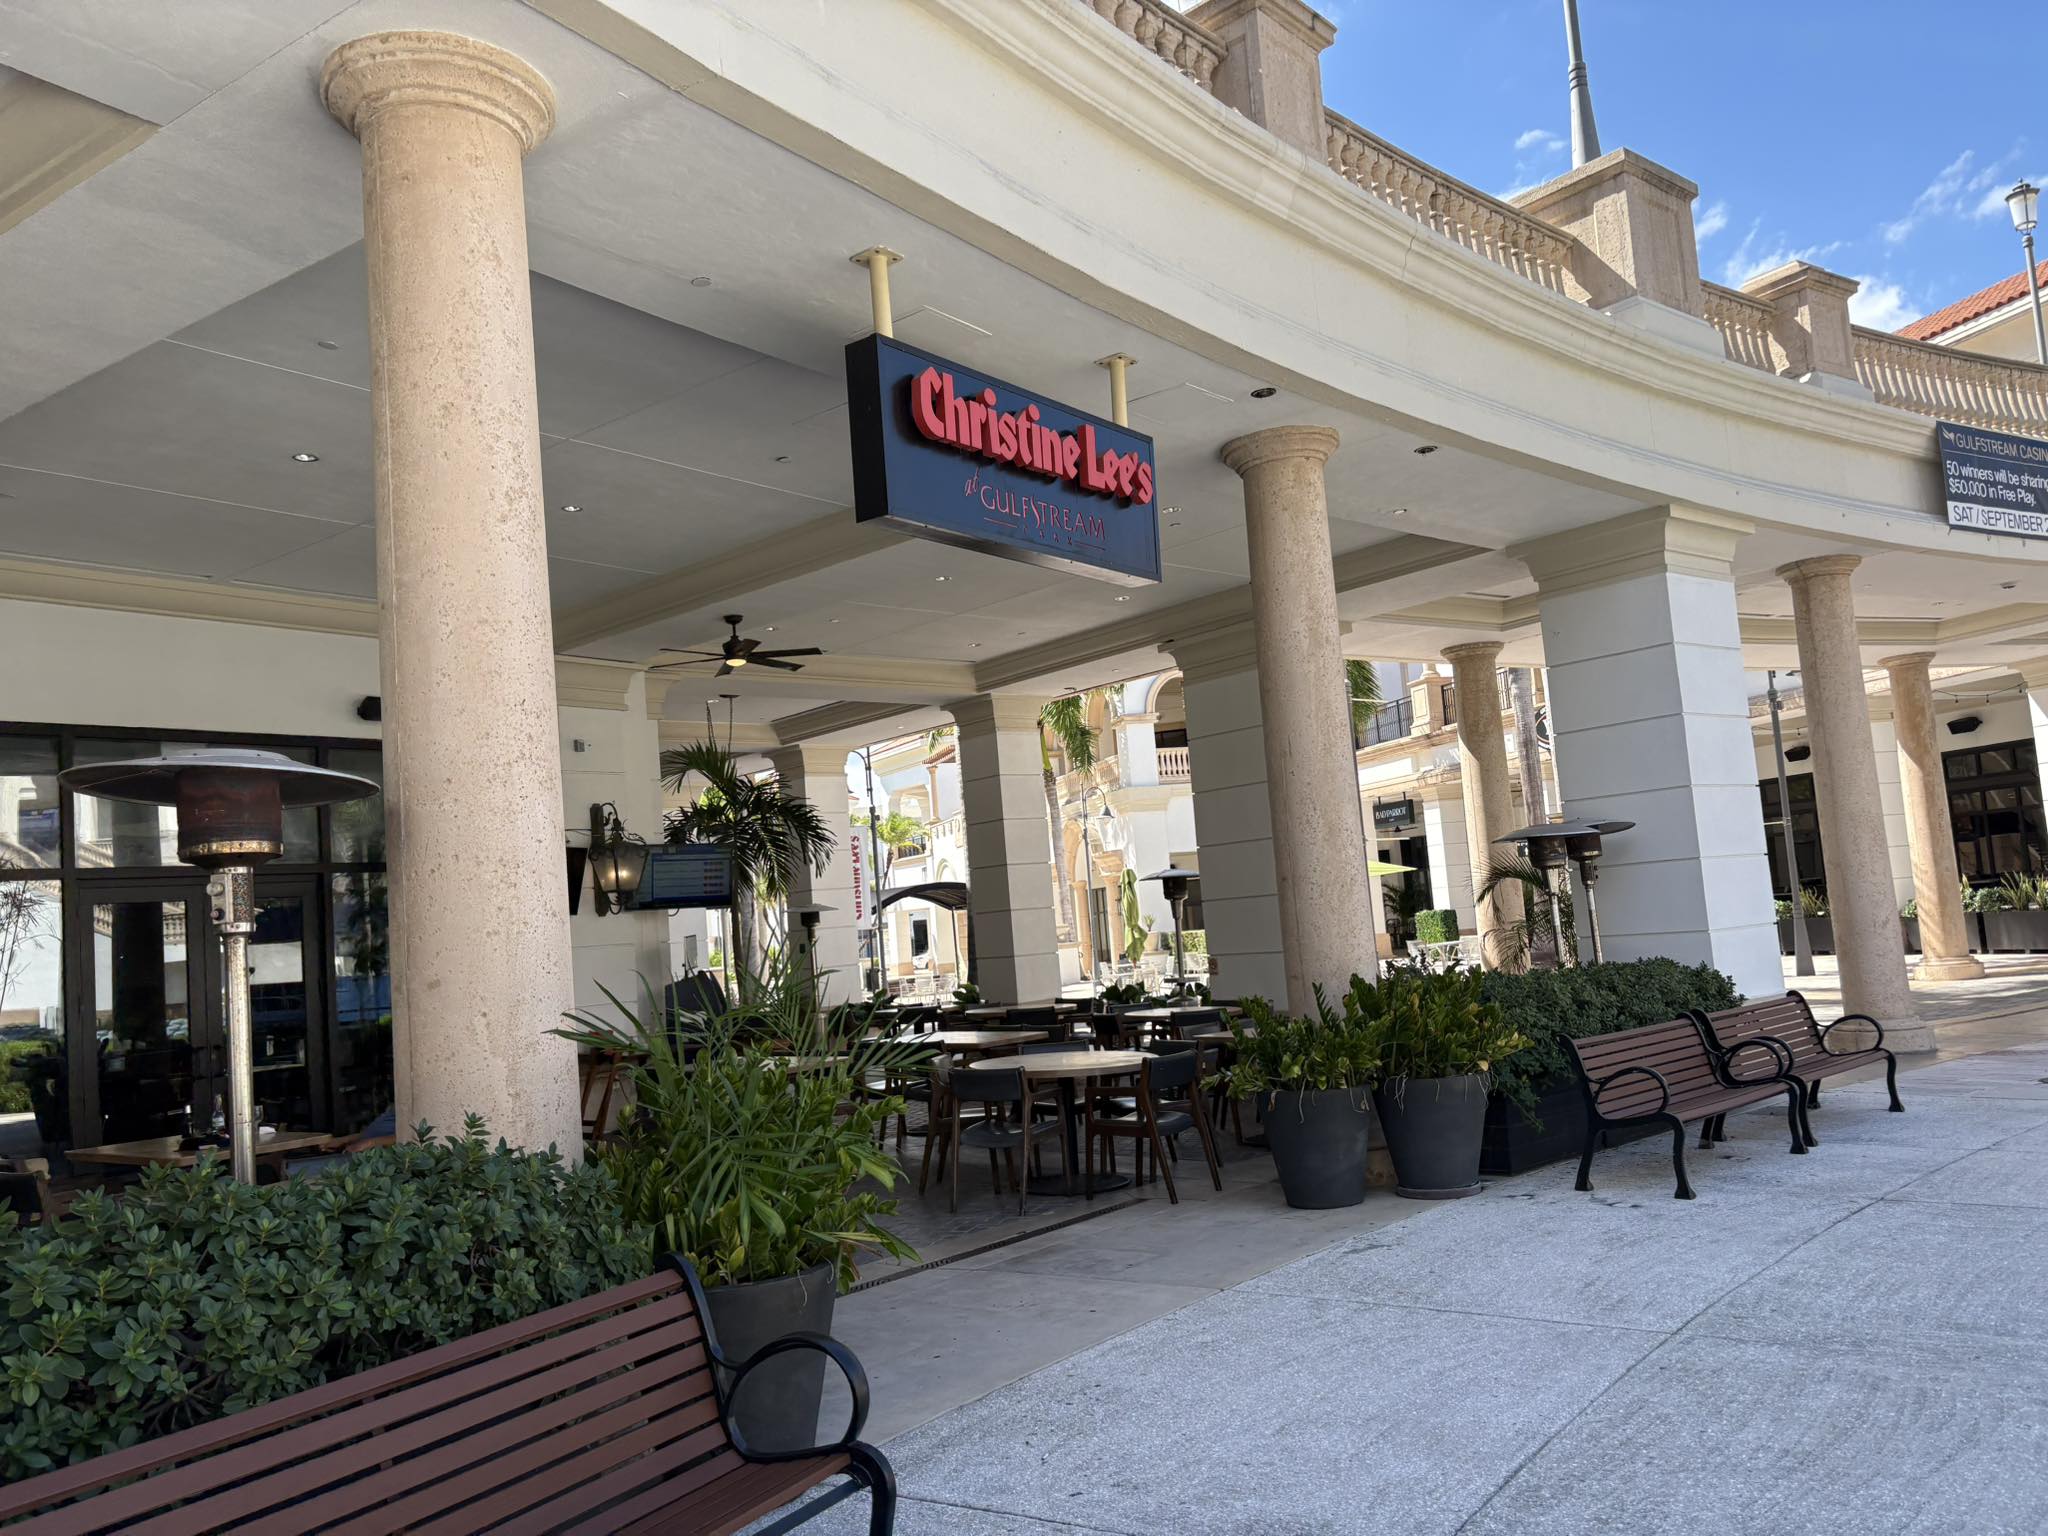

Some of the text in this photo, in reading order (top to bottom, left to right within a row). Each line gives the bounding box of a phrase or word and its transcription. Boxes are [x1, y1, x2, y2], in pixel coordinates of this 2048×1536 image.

[911, 366, 1153, 504] Christine Lee's
[1955, 432, 2048, 462] GULFSTREAM CASIN
[1946, 460, 1960, 477] 50
[1960, 463, 1994, 482] winners
[1994, 468, 2008, 484] will
[2007, 471, 2020, 486] be
[1948, 477, 2037, 508] $50,000 in Free Play.
[980, 485, 1106, 542] GULFSTREAM
[1953, 504, 1974, 522] SAT
[1981, 508, 2044, 534] SEPTEMBER
